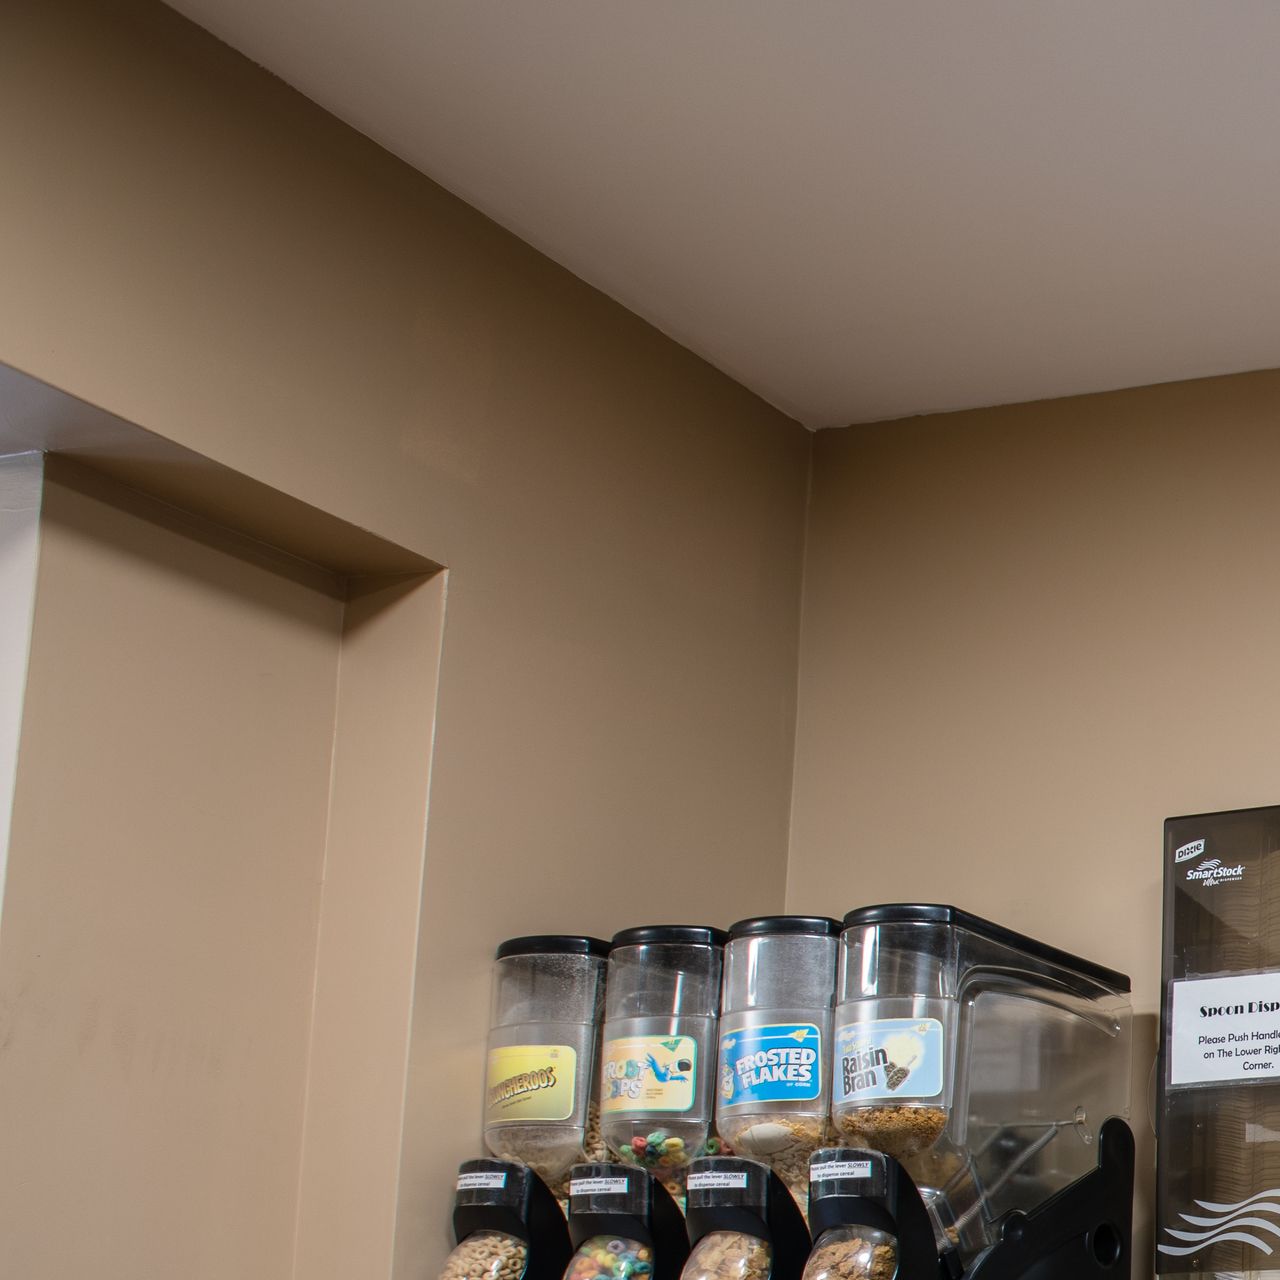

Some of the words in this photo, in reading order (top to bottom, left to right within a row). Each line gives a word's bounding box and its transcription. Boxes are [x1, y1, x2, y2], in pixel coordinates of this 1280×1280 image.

[1186, 864, 1243, 880] SmartStock
[1199, 1004, 1244, 1018] Spoon
[1198, 1035, 1226, 1045] Please
[1228, 1032, 1249, 1043] Push
[1203, 1051, 1215, 1059] on
[1216, 1048, 1233, 1058] The
[1235, 1046, 1262, 1057] Lower
[735, 1047, 817, 1076] FROSTED
[842, 1047, 888, 1076] Raisin
[1242, 1061, 1275, 1071] Corner.
[741, 1063, 813, 1089] FLAKES
[843, 1069, 877, 1096] Bran
